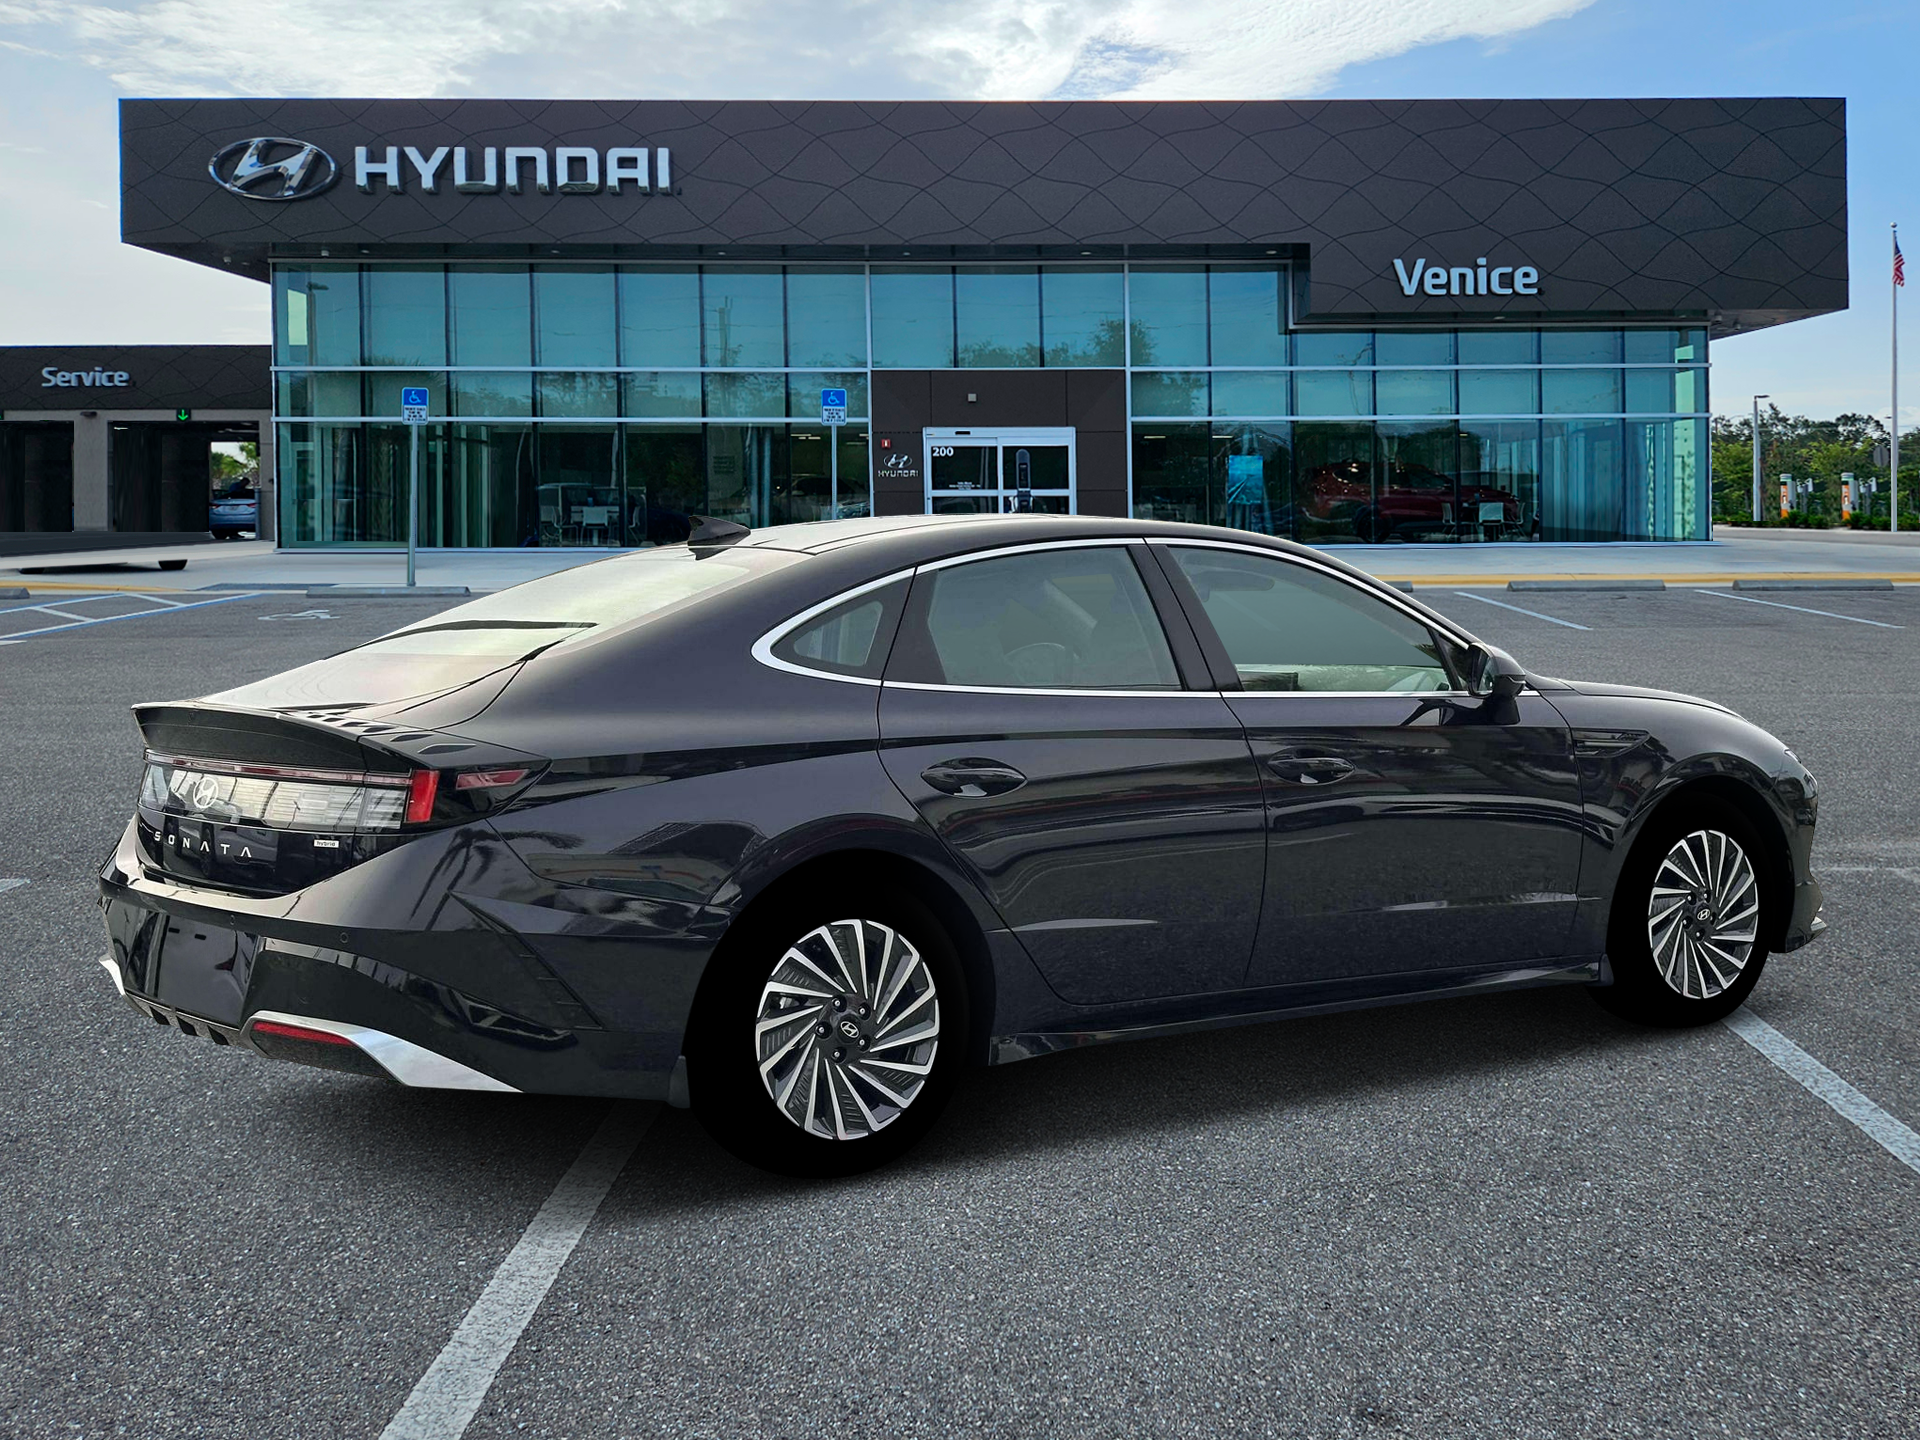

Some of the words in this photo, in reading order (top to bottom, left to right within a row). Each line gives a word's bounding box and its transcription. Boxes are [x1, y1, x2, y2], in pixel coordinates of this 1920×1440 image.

[354, 146, 673, 195] HYUNDAI
[1392, 256, 1539, 296] Venice
[41, 366, 130, 388] Service
[932, 446, 954, 457] 200
[878, 469, 919, 477] HYUNDAI
[153, 830, 252, 858] SONATA
